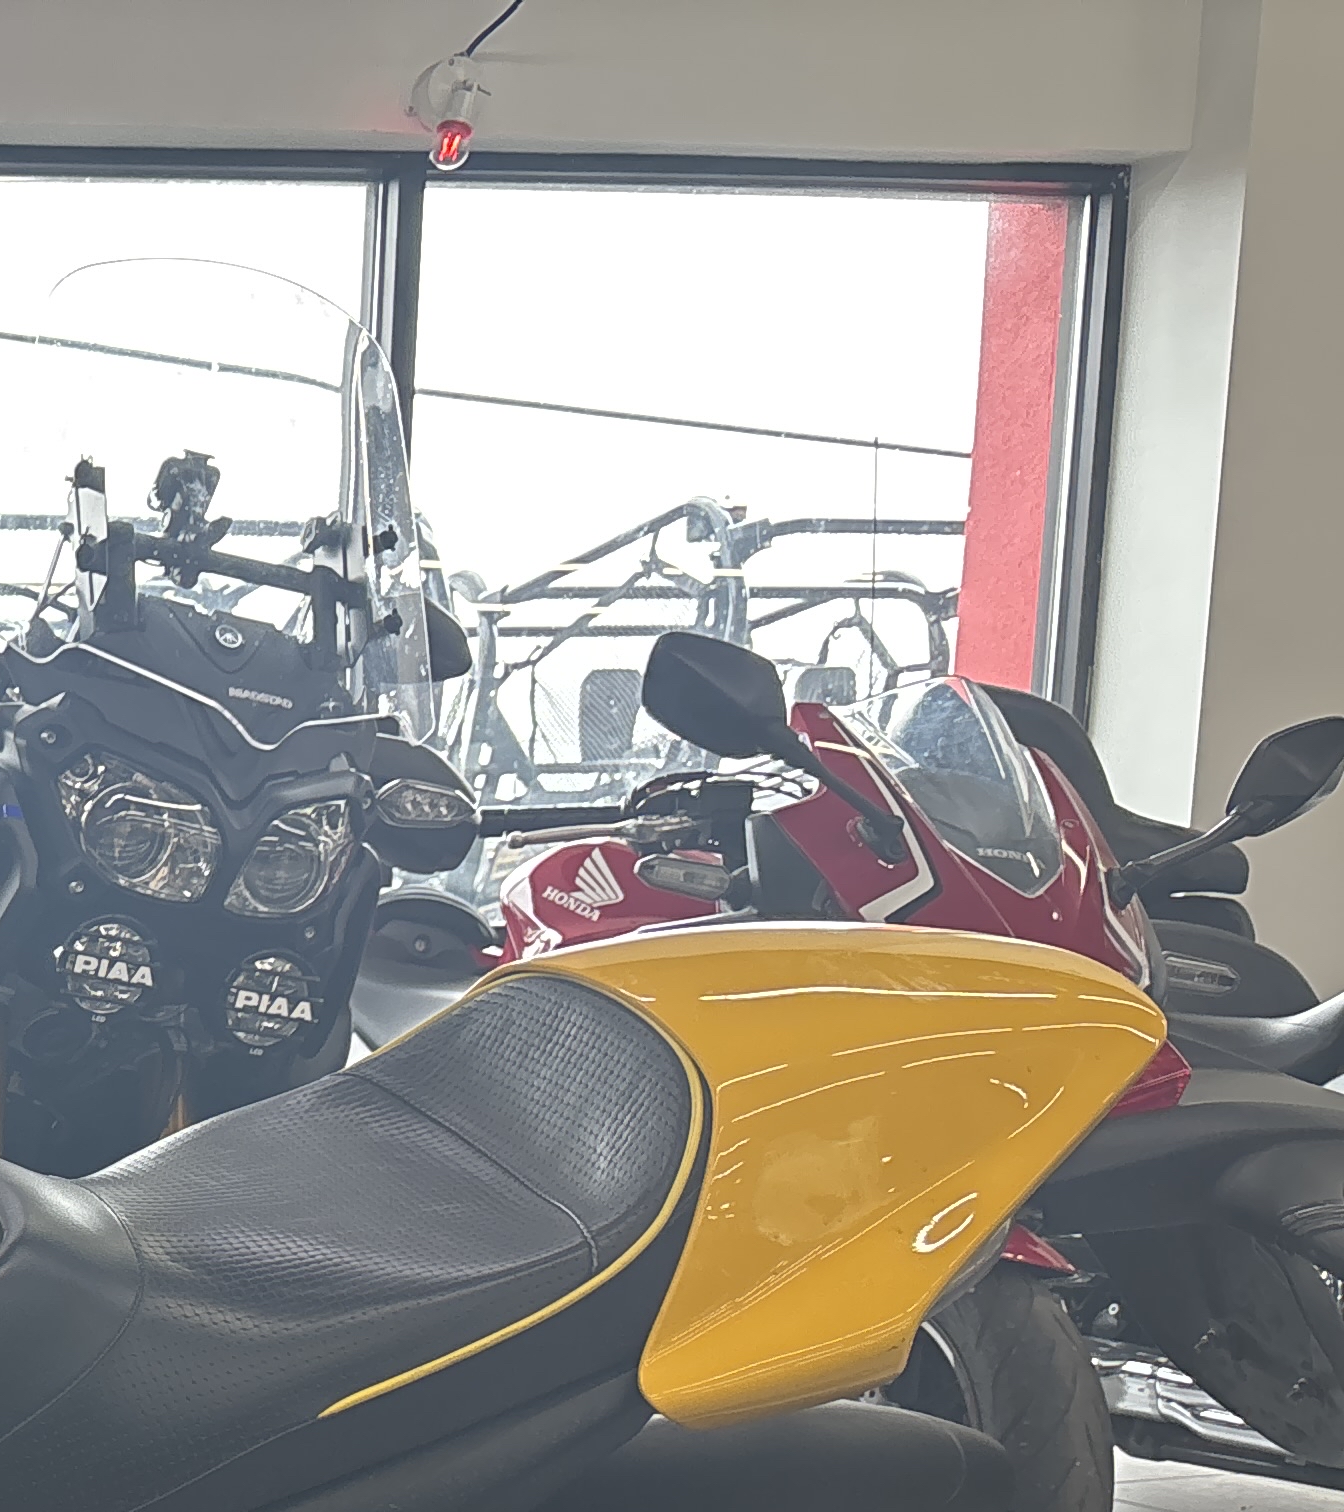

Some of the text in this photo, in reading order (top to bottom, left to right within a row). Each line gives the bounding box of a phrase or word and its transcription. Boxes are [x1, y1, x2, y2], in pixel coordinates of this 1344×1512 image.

[541, 885, 601, 922] HONDA
[73, 954, 153, 988] PIAA
[91, 1014, 107, 1024] LED
[233, 990, 313, 1022] PIAA
[249, 1047, 264, 1057] LED
